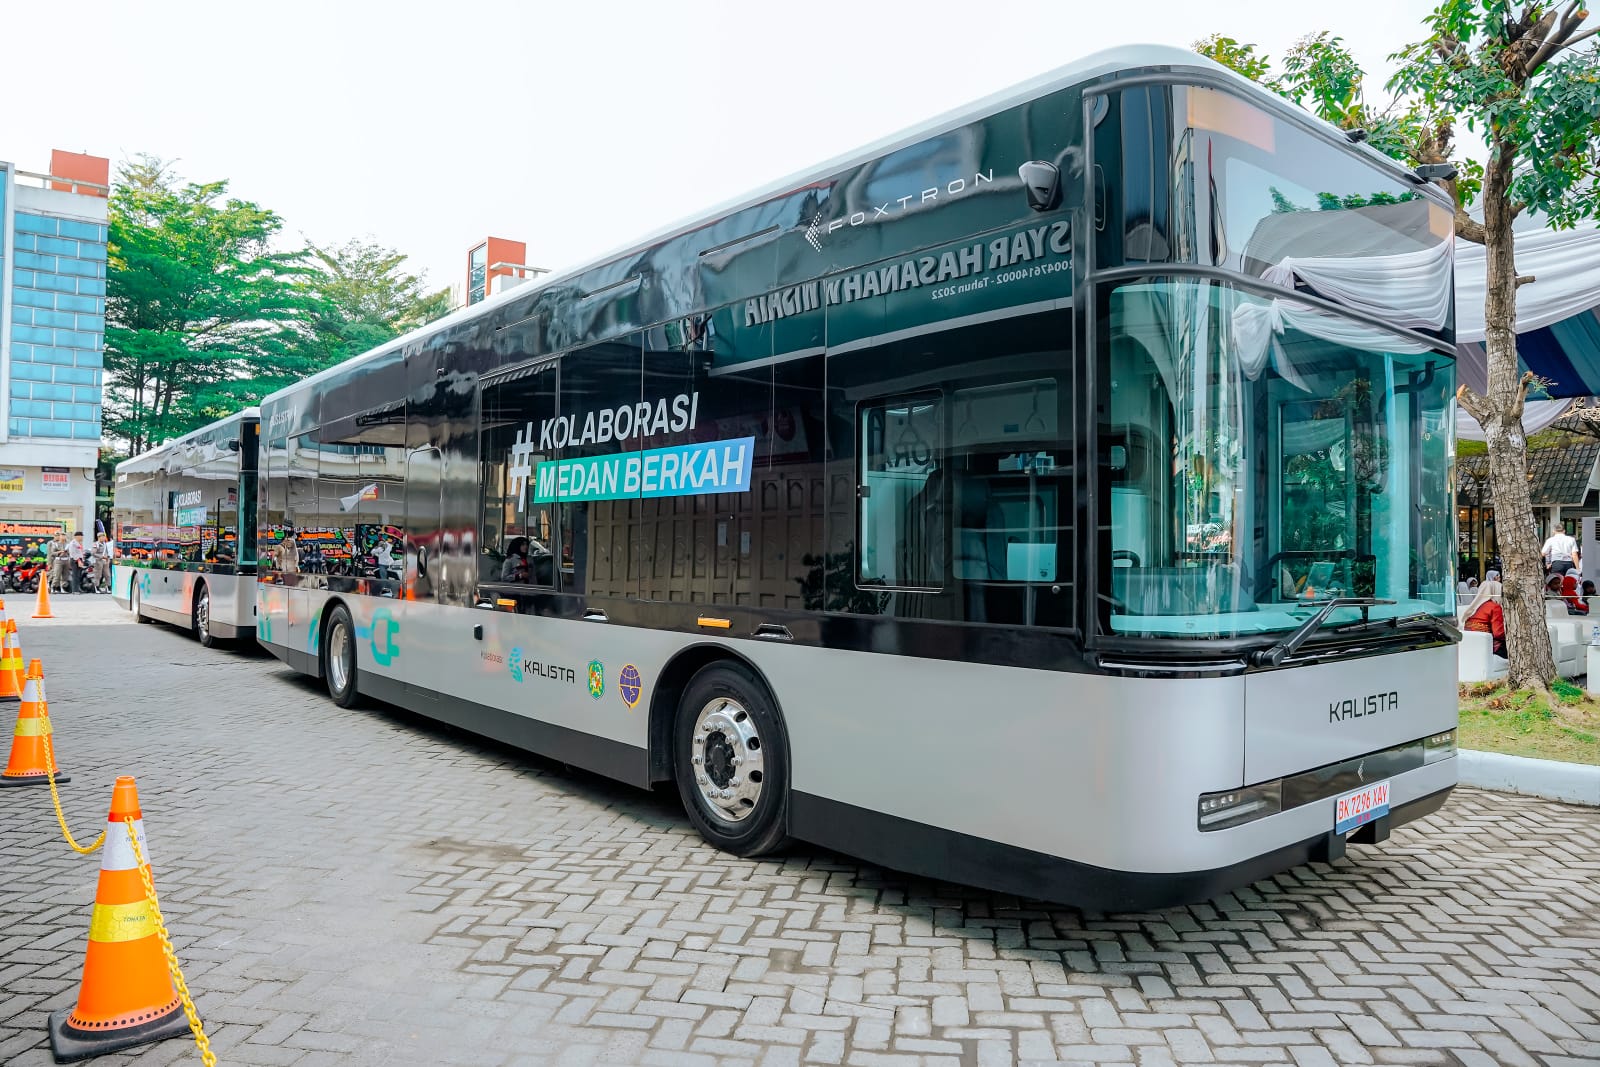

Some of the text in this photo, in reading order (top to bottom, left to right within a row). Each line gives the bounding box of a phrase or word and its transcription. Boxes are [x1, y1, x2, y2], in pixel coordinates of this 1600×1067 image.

[828, 168, 994, 234] FOXTRON
[538, 445, 746, 498] MEDAN BERKAH
[524, 659, 575, 684] KALISTA
[1329, 691, 1398, 723] KALISTA
[1338, 798, 1350, 821] BK
[1351, 790, 1371, 816] 7296
